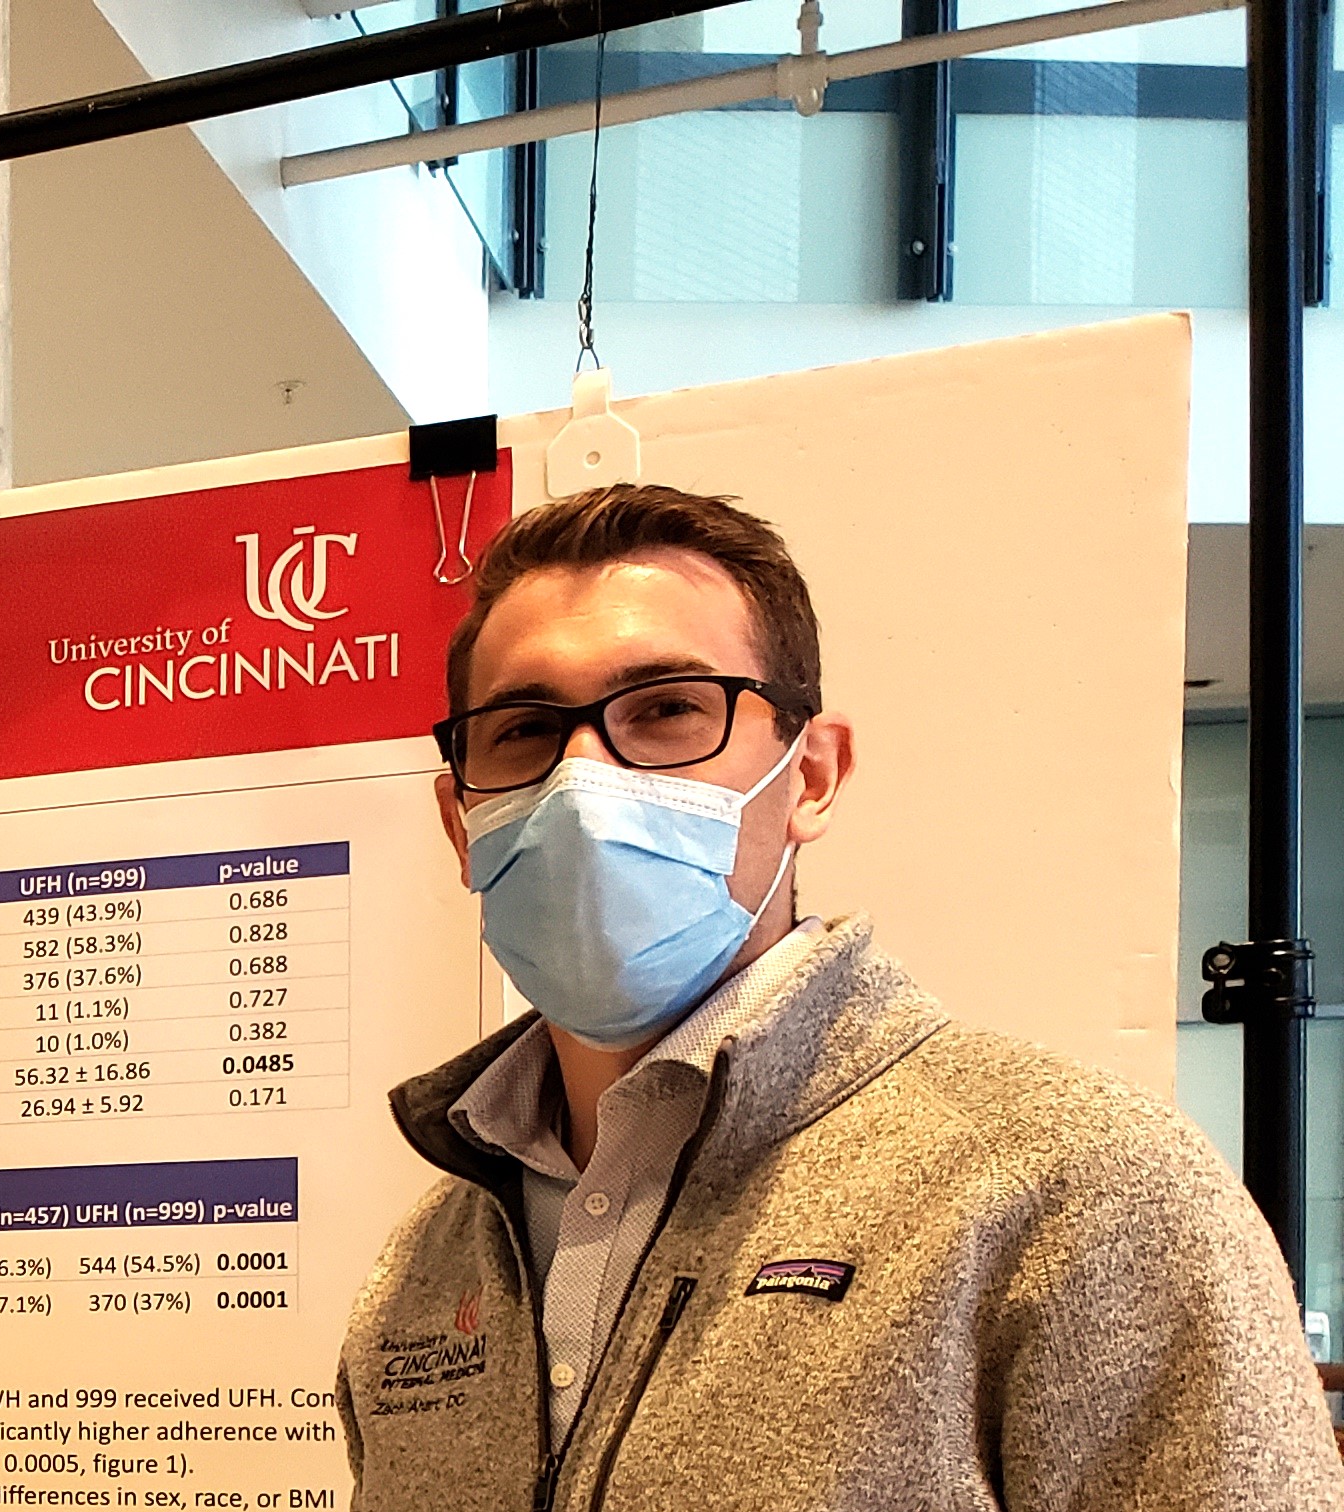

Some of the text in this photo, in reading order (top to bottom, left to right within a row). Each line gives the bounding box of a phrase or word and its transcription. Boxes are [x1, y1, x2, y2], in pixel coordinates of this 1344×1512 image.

[49, 618, 232, 663] University of
[84, 632, 399, 711] CINCINNATI
[20, 875, 62, 896] UFH
[67, 865, 147, 895] (n=999)
[219, 855, 299, 883] p-value
[23, 907, 59, 926] 439
[67, 899, 141, 927] (43.9%)
[230, 889, 288, 910] 0.686
[76, 1203, 118, 1223] UFH
[124, 1200, 206, 1226] (n=999)
[213, 1197, 293, 1223] p-value
[79, 1257, 116, 1274] 544
[124, 1253, 200, 1277] (54.5%)
[217, 1252, 288, 1271] 0.0001
[756, 1276, 830, 1290] patagonia
[28, 1388, 68, 1408] and
[76, 1389, 116, 1408] 999
[125, 1387, 219, 1408] received
[229, 1388, 282, 1407] UFH.
